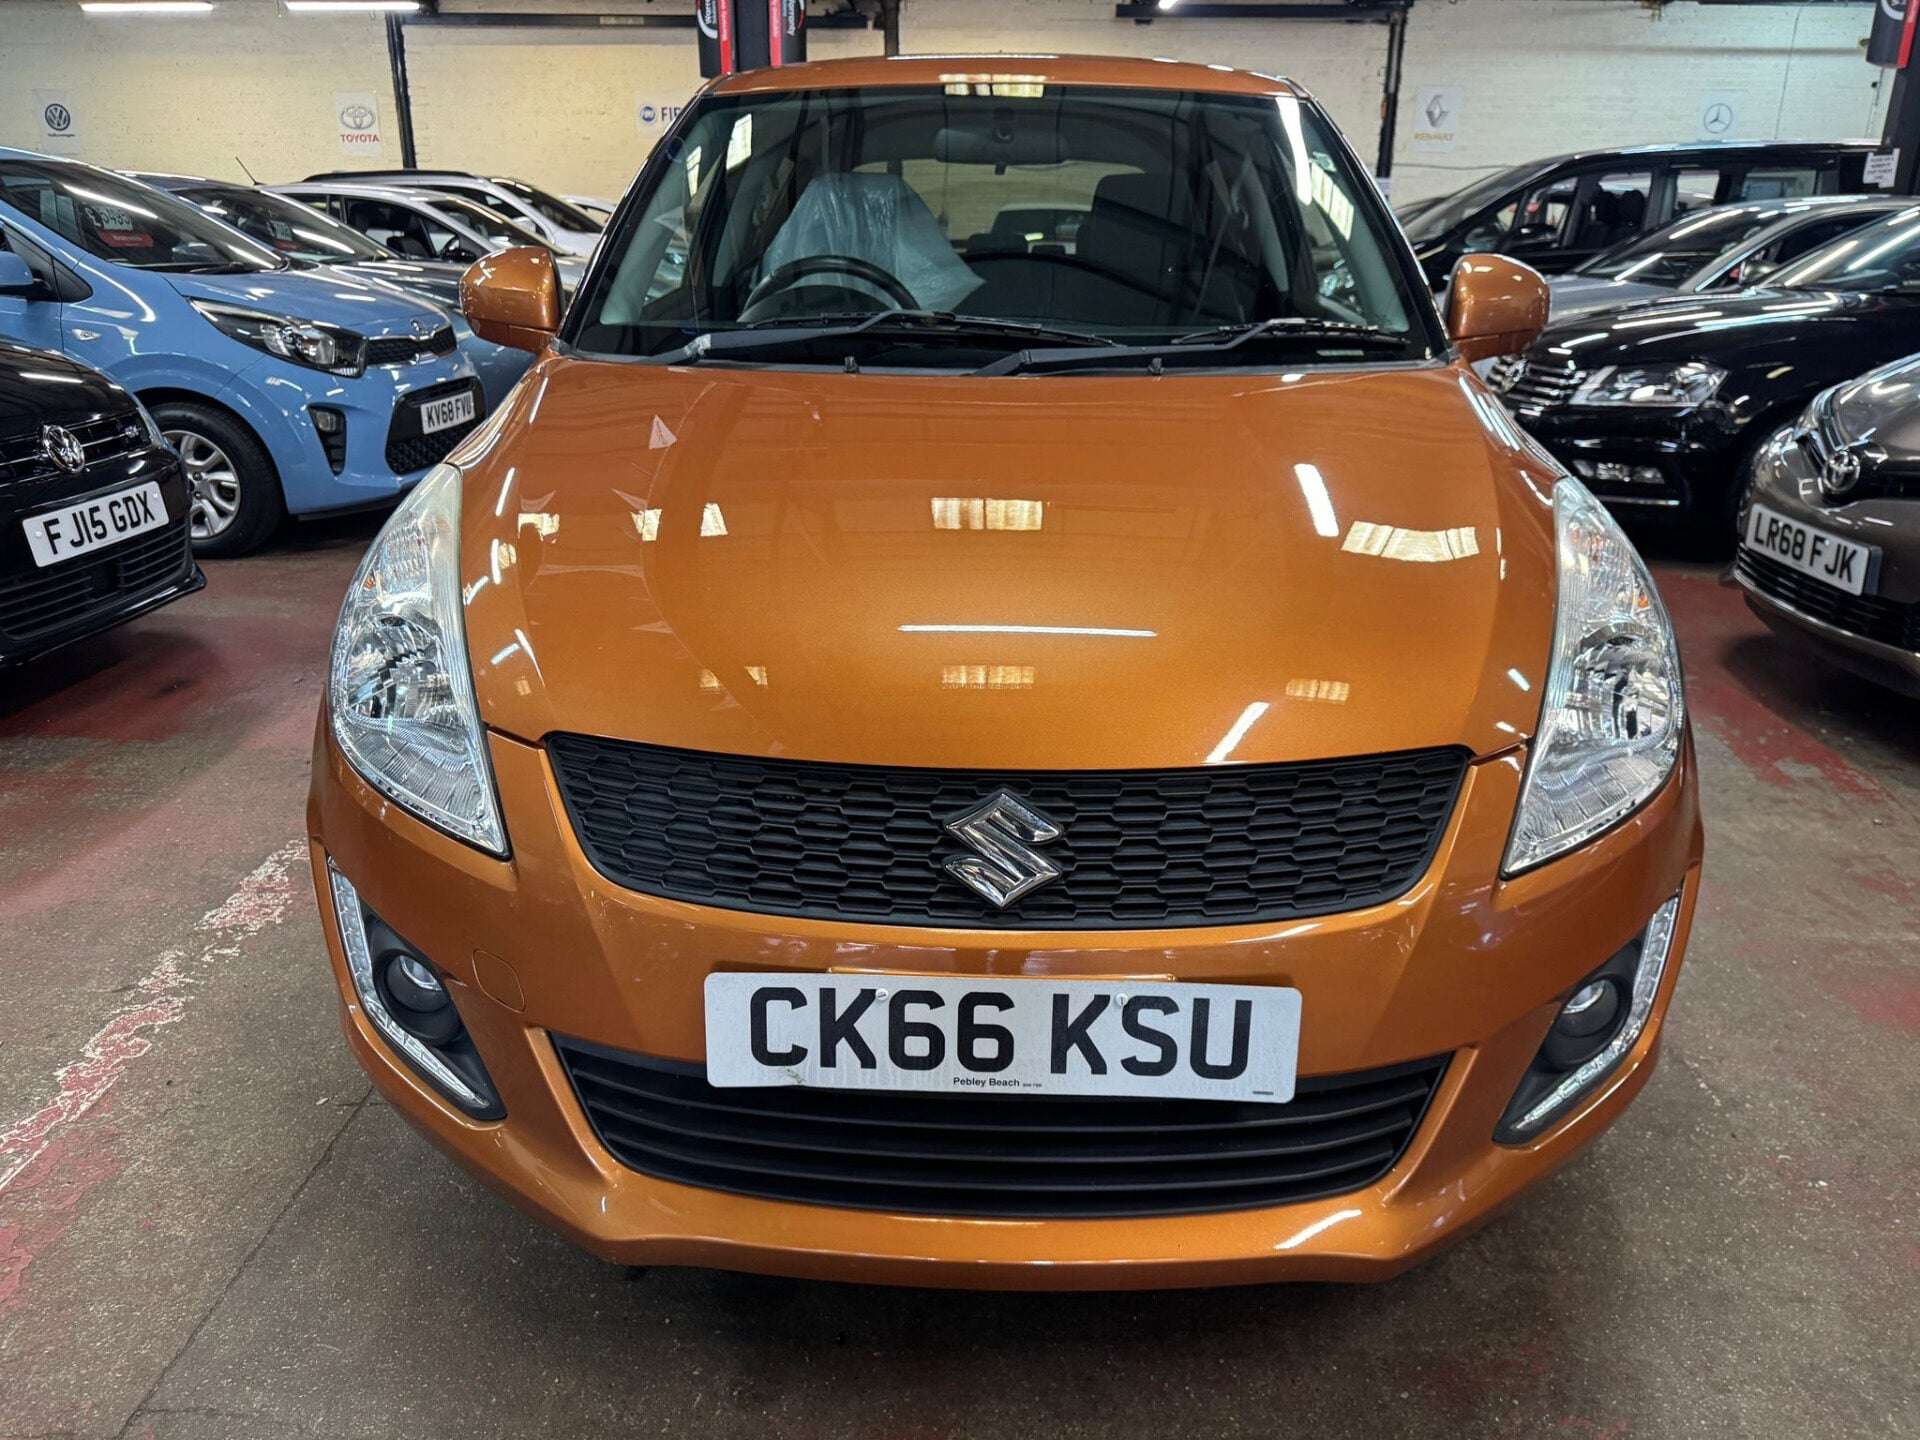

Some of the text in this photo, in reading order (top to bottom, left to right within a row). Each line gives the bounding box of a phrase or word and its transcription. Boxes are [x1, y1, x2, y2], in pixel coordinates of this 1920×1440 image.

[340, 134, 380, 143] TOYOTA
[43, 490, 155, 555] FJ15 GDX
[1754, 512, 1858, 583] LR68 FJK
[750, 987, 1252, 1080] CK66 KSU
[953, 1077, 986, 1087] Pebley
[989, 1078, 1020, 1087] Beach
